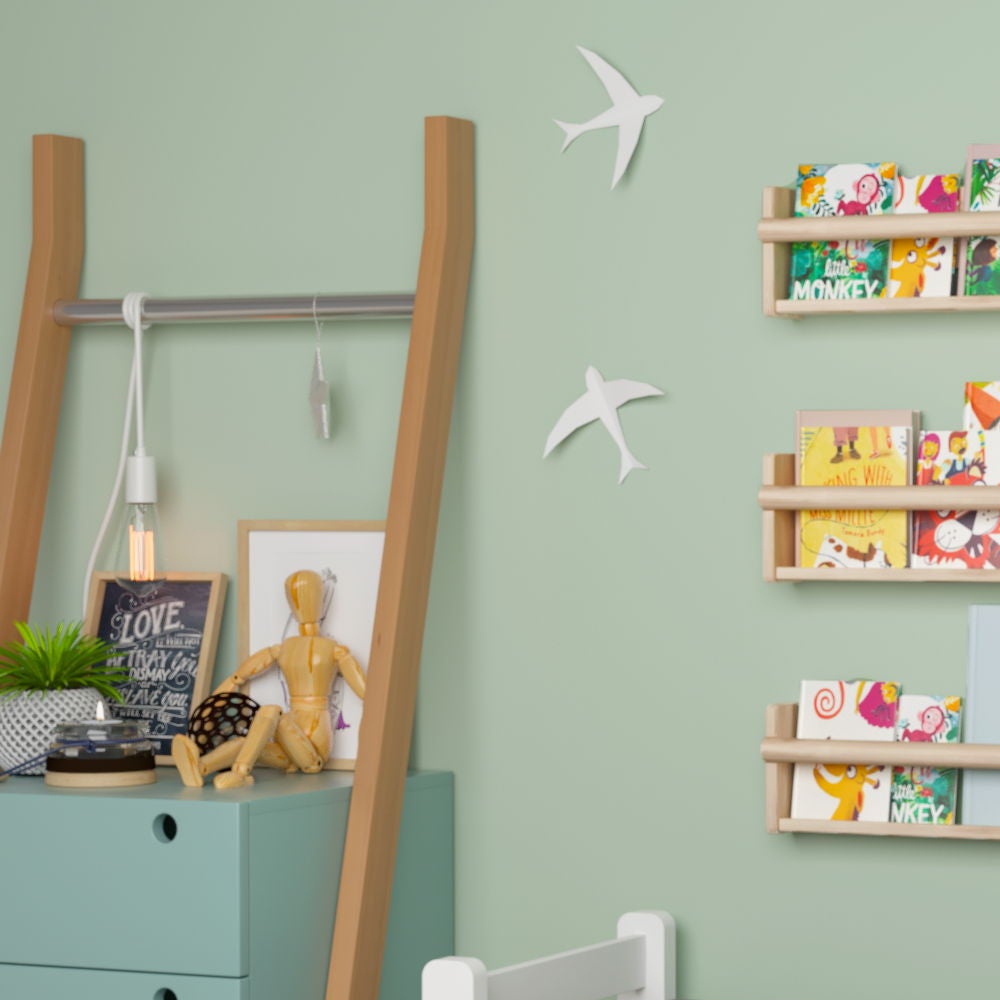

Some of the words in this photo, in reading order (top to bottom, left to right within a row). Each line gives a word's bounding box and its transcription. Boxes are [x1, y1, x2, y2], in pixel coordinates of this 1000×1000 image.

[793, 279, 879, 300] MONKEY
[863, 464, 894, 486] WITH
[119, 600, 186, 644] LOVE.
[891, 803, 945, 823] NKEY
